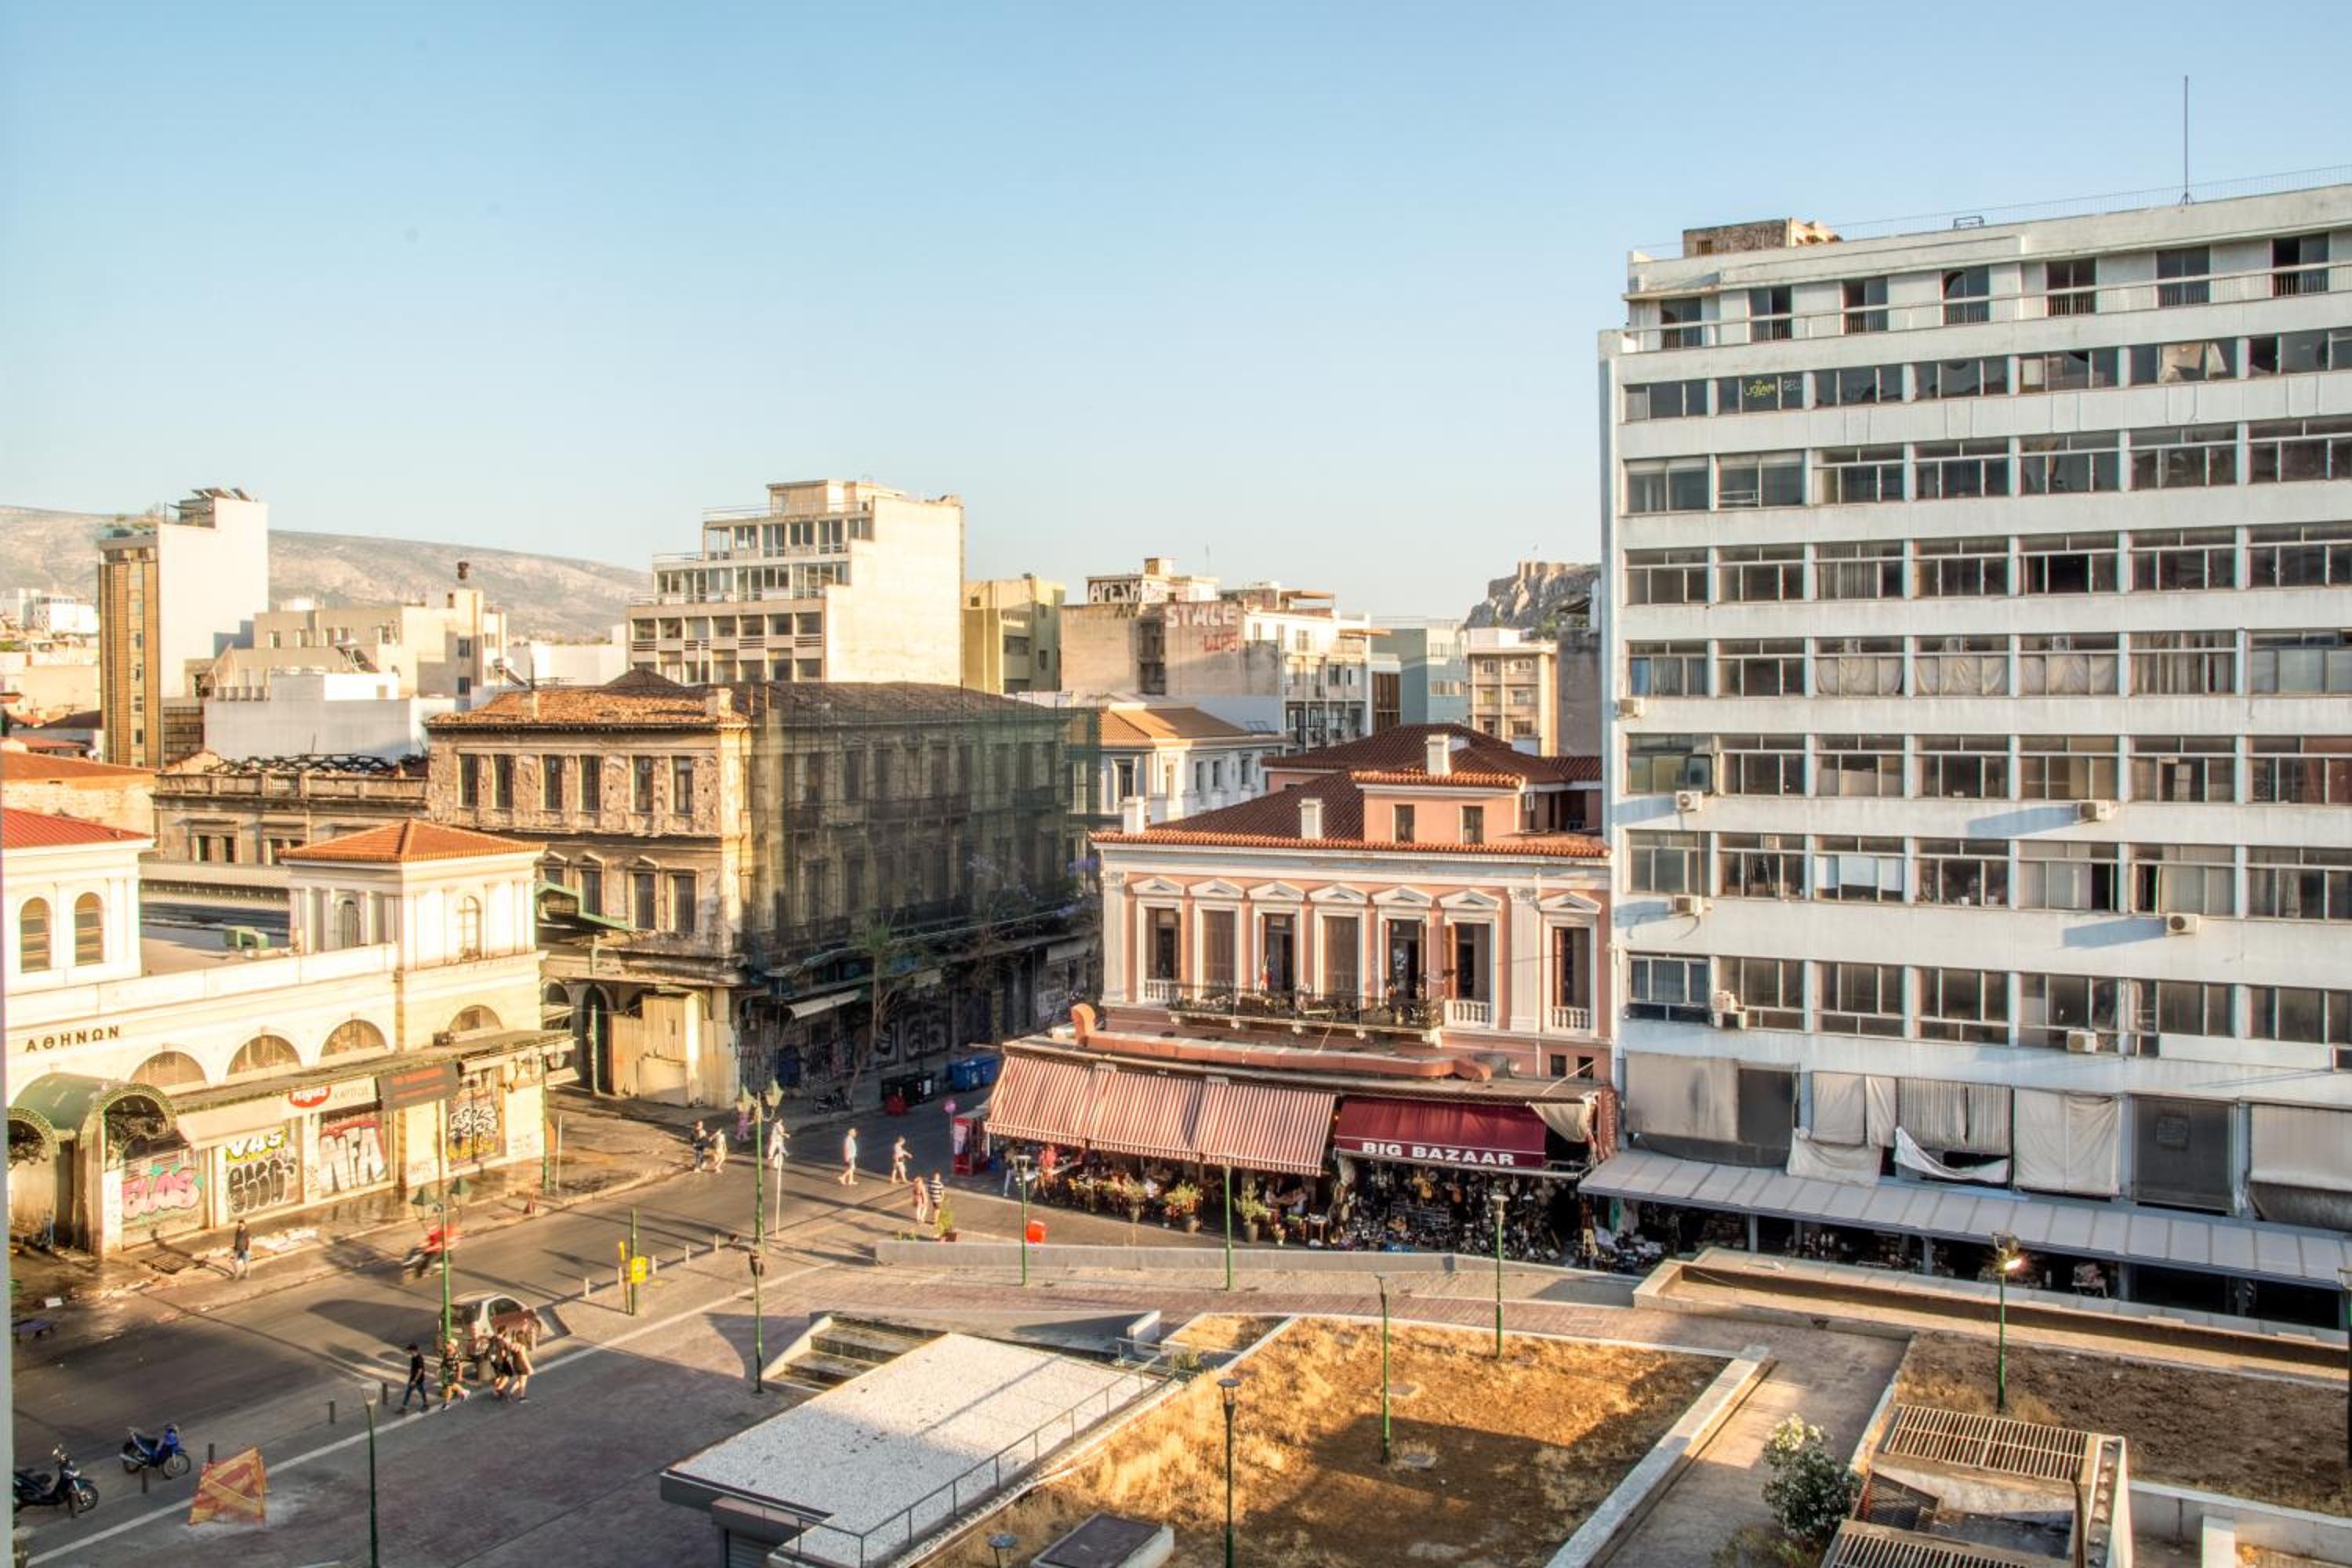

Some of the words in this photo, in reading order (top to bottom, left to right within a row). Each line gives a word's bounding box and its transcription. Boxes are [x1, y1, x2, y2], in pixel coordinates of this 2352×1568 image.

[25, 1025, 119, 1052] ΑΘΗΝΩΝ
[1362, 1142, 1403, 1156] BIG
[1411, 1145, 1515, 1166] BAZAAR
